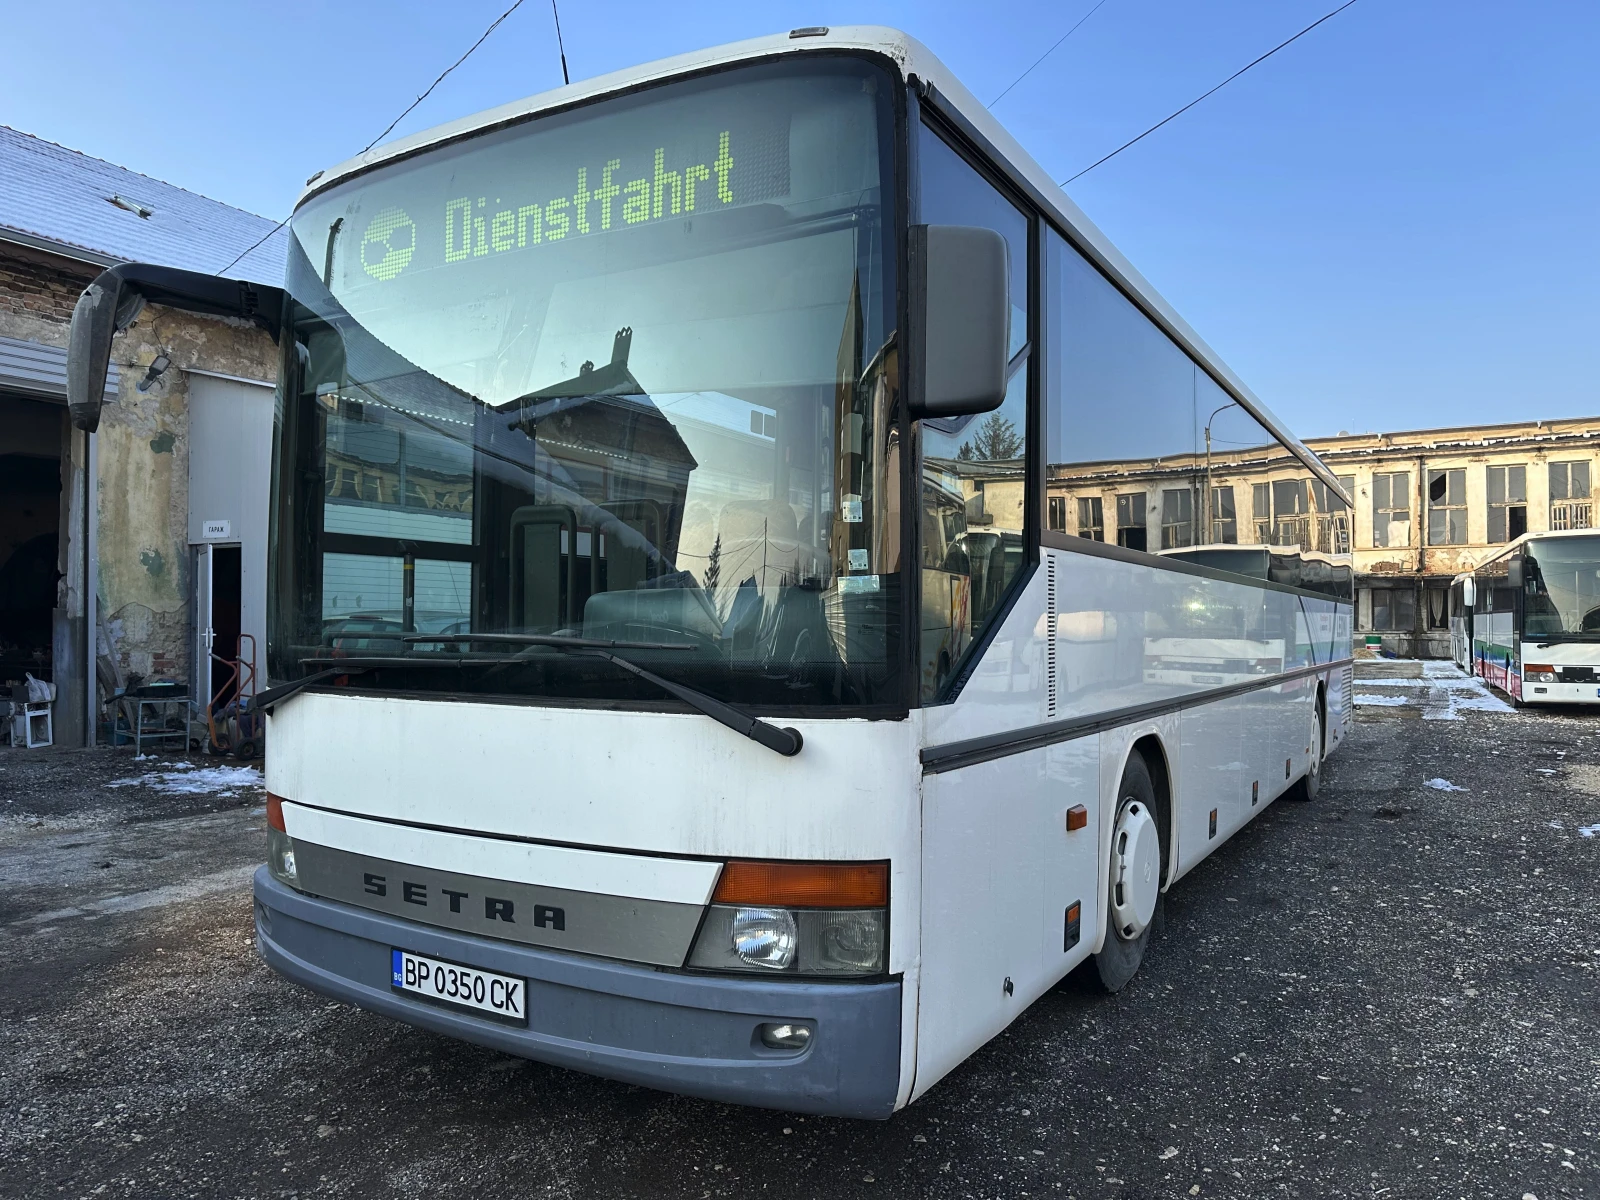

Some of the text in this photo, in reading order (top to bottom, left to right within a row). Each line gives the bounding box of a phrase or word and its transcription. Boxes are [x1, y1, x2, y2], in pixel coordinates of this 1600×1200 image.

[445, 130, 734, 263] Dienstfahrt
[363, 872, 566, 932] SETRA
[393, 971, 402, 982] BG
[405, 957, 520, 1013] BP 0350 CK
